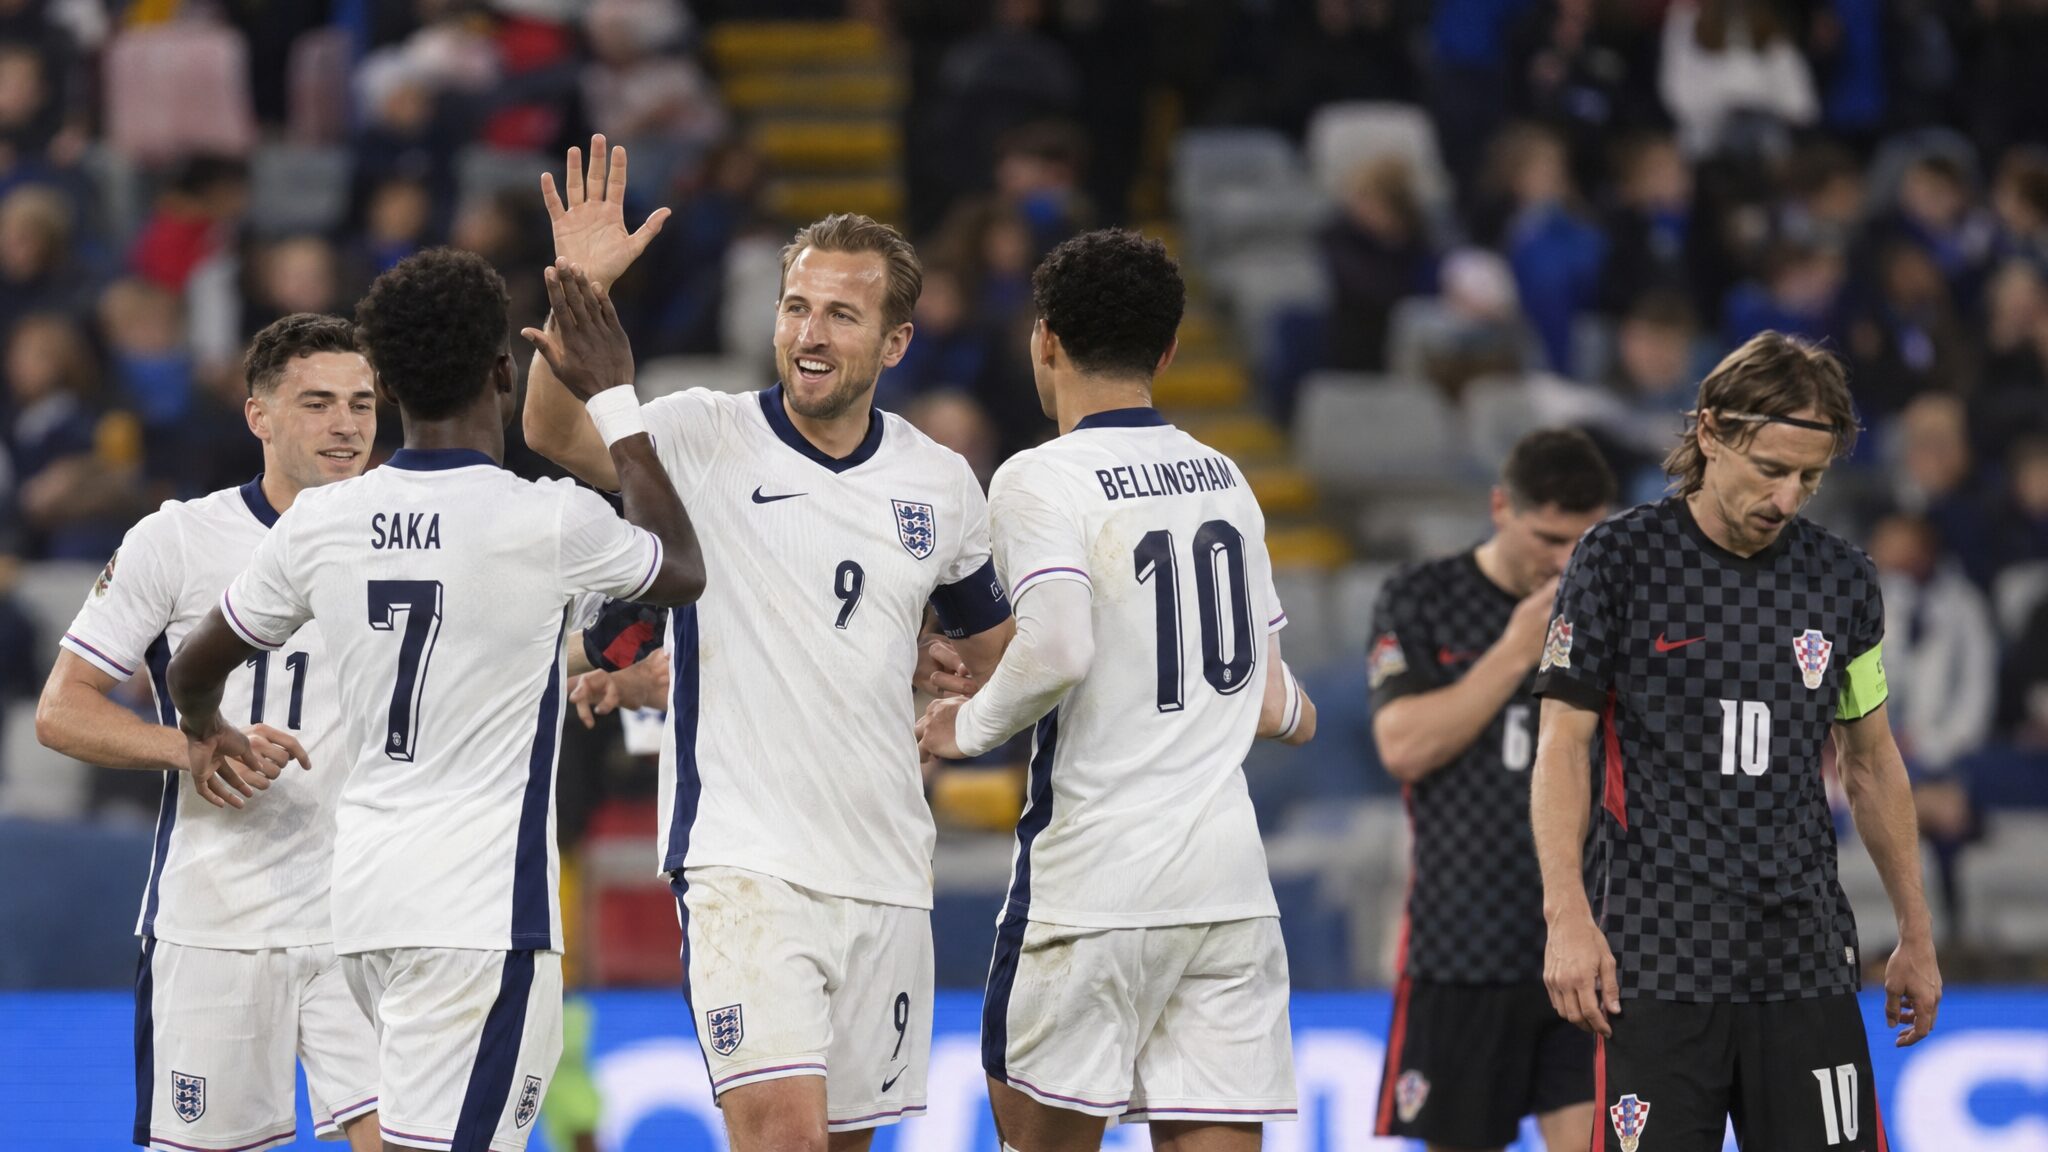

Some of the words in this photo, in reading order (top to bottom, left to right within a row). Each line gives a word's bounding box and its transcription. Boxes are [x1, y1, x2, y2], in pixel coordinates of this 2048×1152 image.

[1095, 457, 1237, 500] BELLINGHAM
[371, 512, 441, 550] SAKA
[834, 560, 866, 630] 9
[1133, 519, 1256, 713] 10
[246, 650, 310, 730] 11
[368, 580, 444, 762] 7
[1502, 704, 1532, 772] 6
[1719, 698, 1771, 776] 10
[890, 991, 910, 1061] 9
[1811, 1062, 1859, 1146] 10
